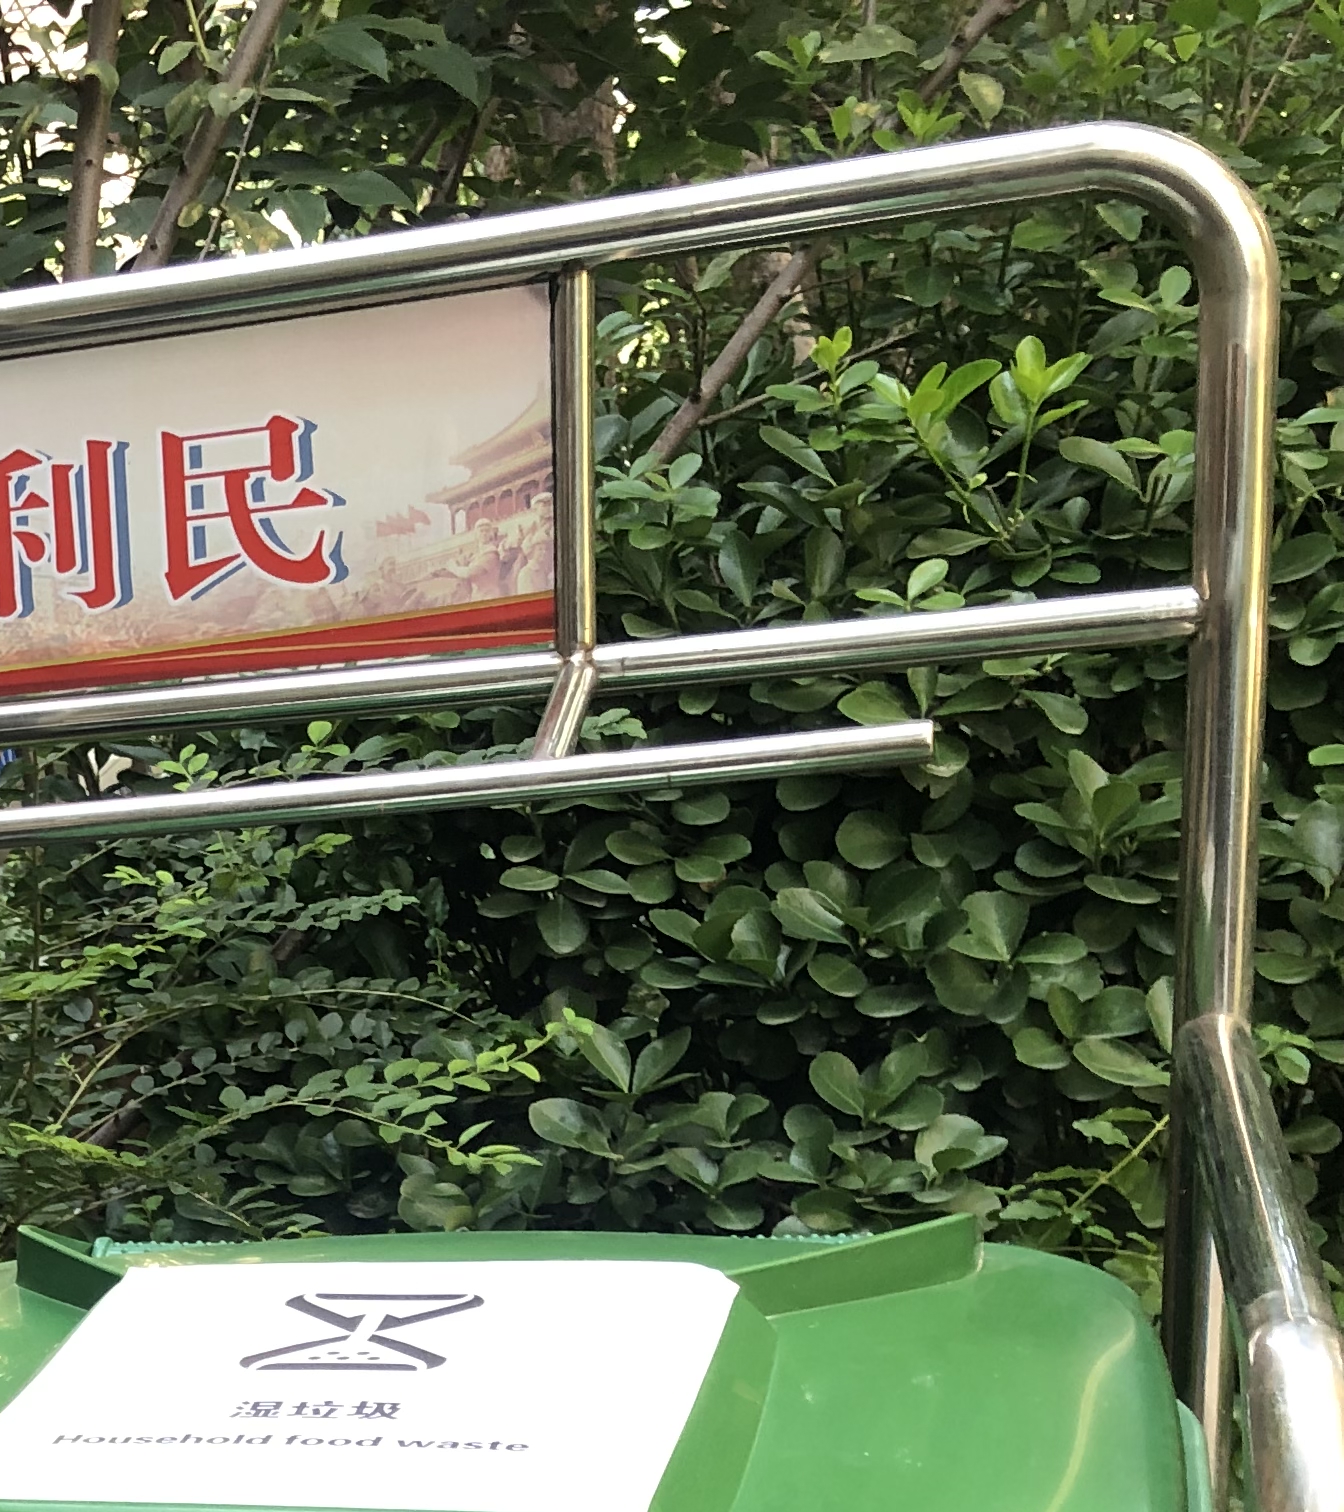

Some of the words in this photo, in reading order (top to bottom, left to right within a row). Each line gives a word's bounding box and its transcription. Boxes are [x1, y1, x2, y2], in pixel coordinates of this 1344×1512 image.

[229, 1400, 402, 1420] 湿垃圾
[52, 1433, 274, 1446] Household
[284, 1434, 384, 1448] food
[396, 1439, 530, 1452] waste
